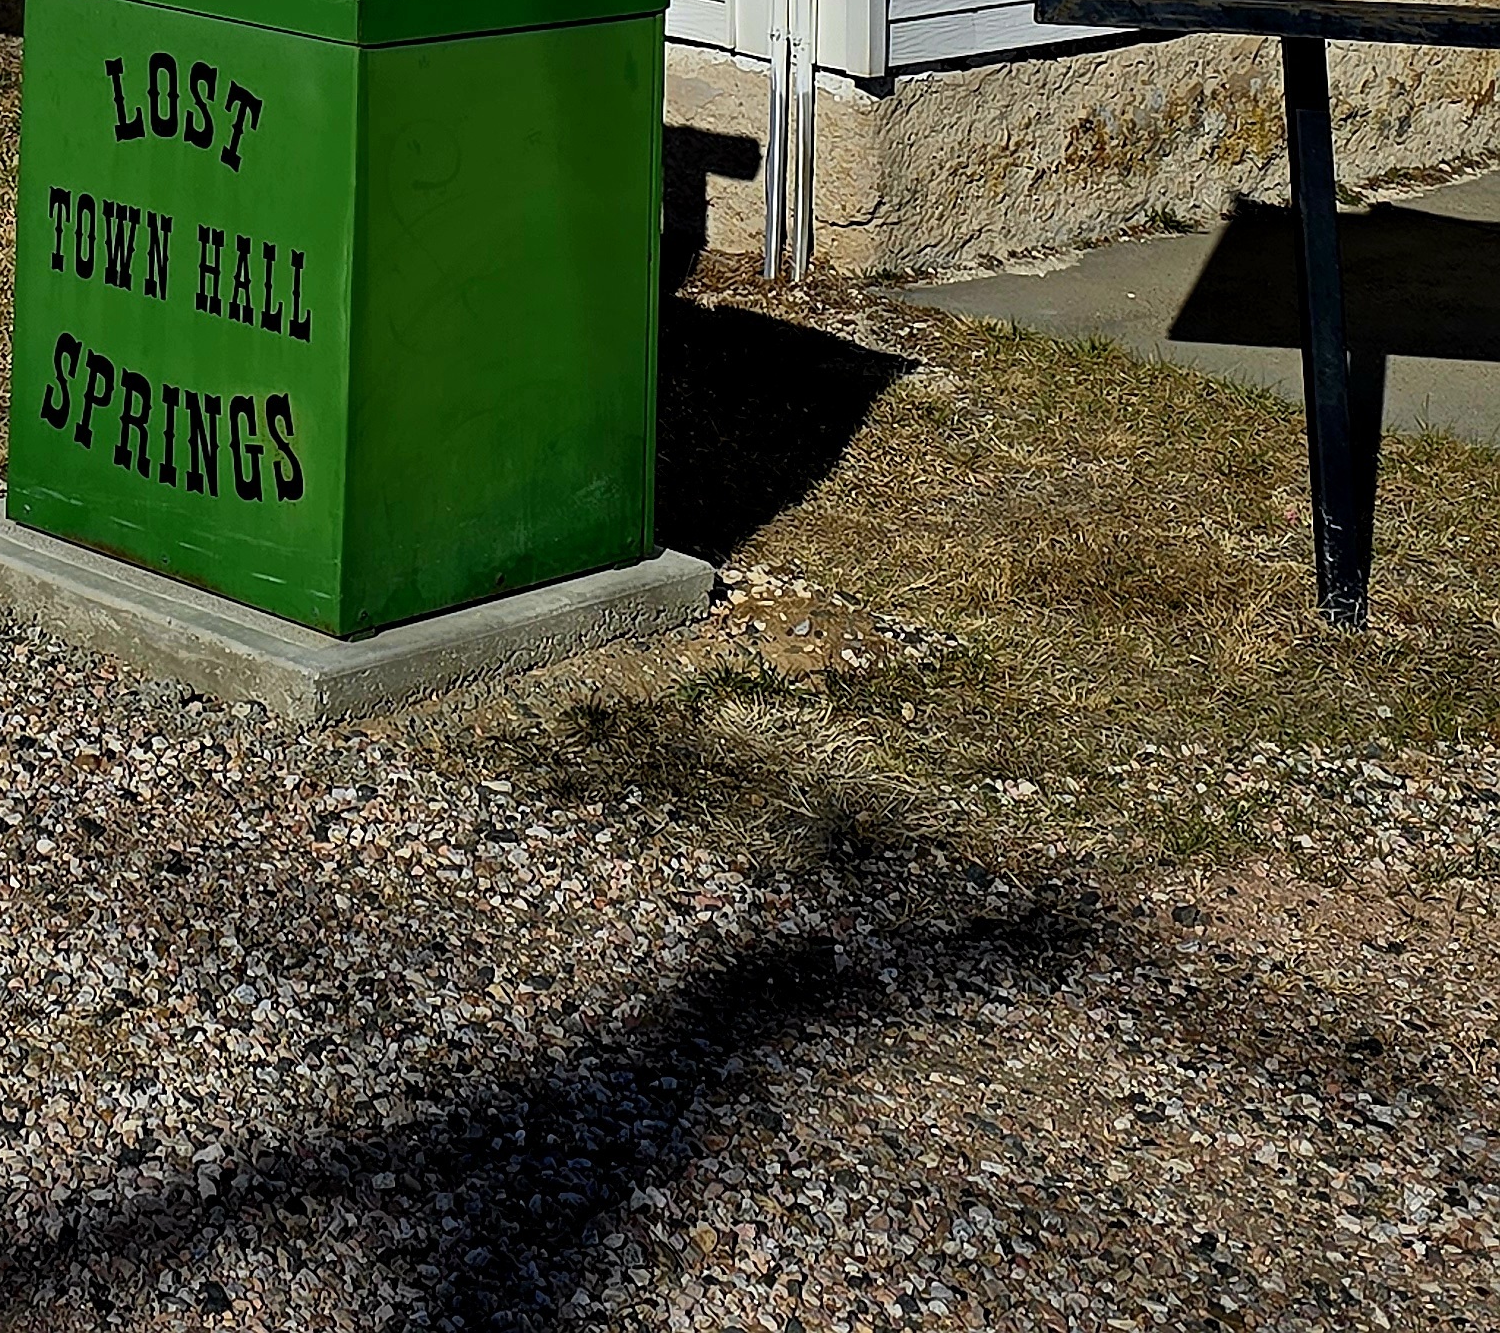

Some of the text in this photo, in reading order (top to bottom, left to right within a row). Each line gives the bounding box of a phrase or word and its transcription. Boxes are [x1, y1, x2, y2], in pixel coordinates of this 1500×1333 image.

[104, 51, 263, 173] LOST
[48, 185, 312, 344] TOWN HALL
[40, 331, 305, 503] SPRINGS
